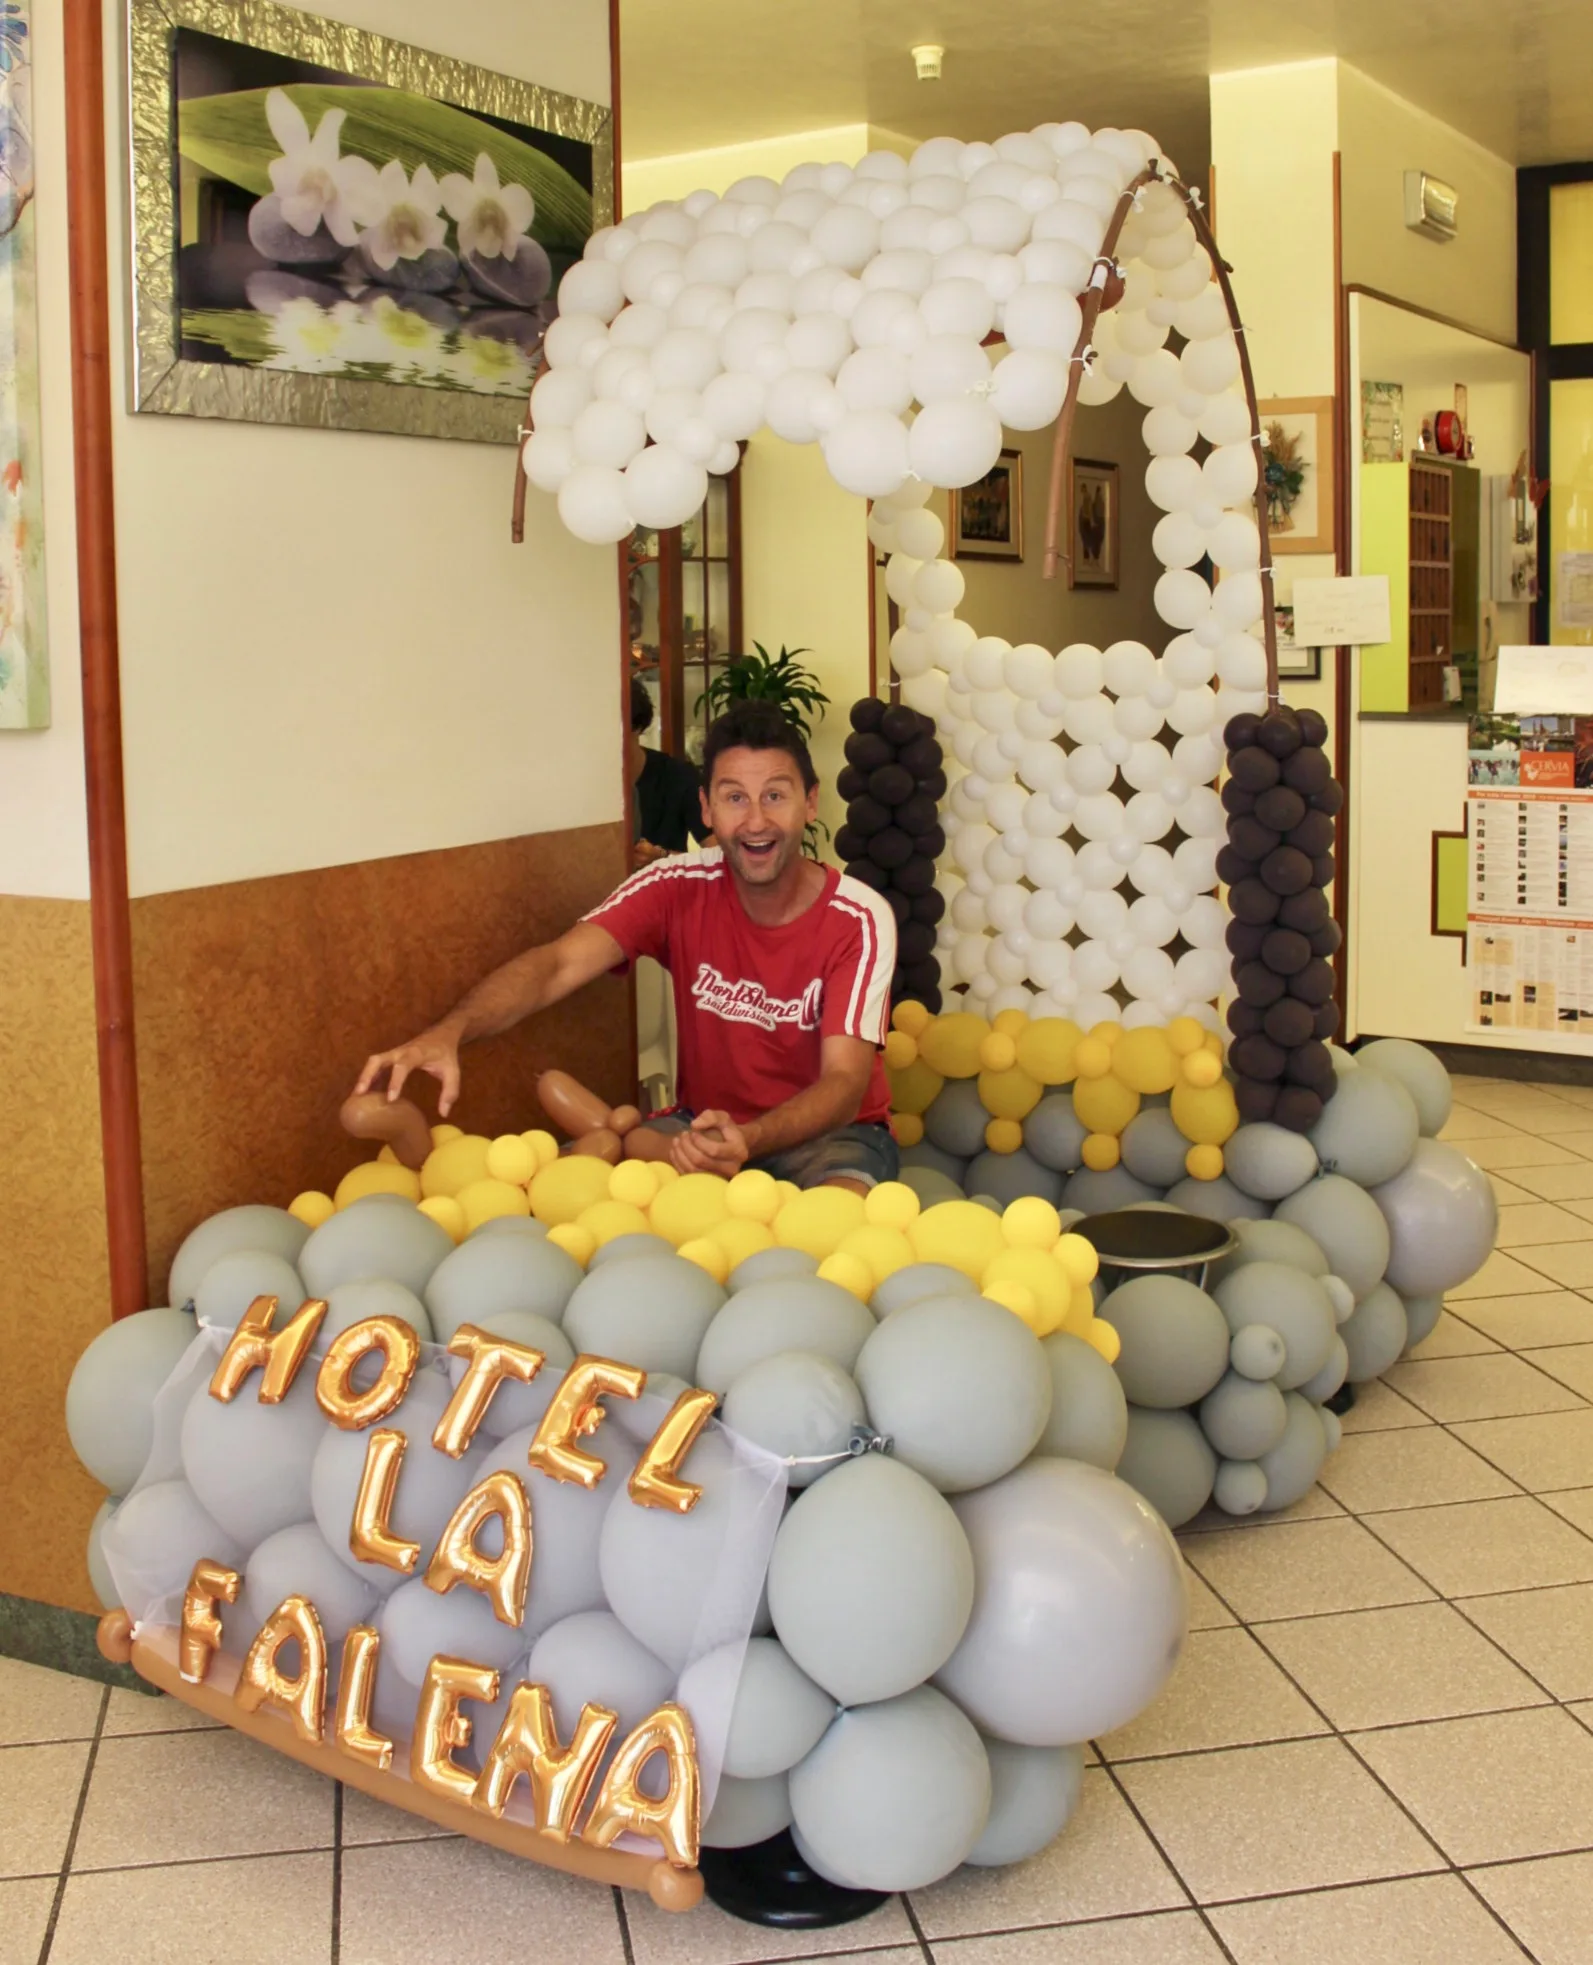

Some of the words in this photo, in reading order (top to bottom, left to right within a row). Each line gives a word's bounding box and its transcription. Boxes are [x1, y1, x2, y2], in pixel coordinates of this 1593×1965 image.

[209, 1294, 718, 1514] HOTEL
[349, 1427, 533, 1628] LA
[179, 1558, 700, 1868] FALENA
